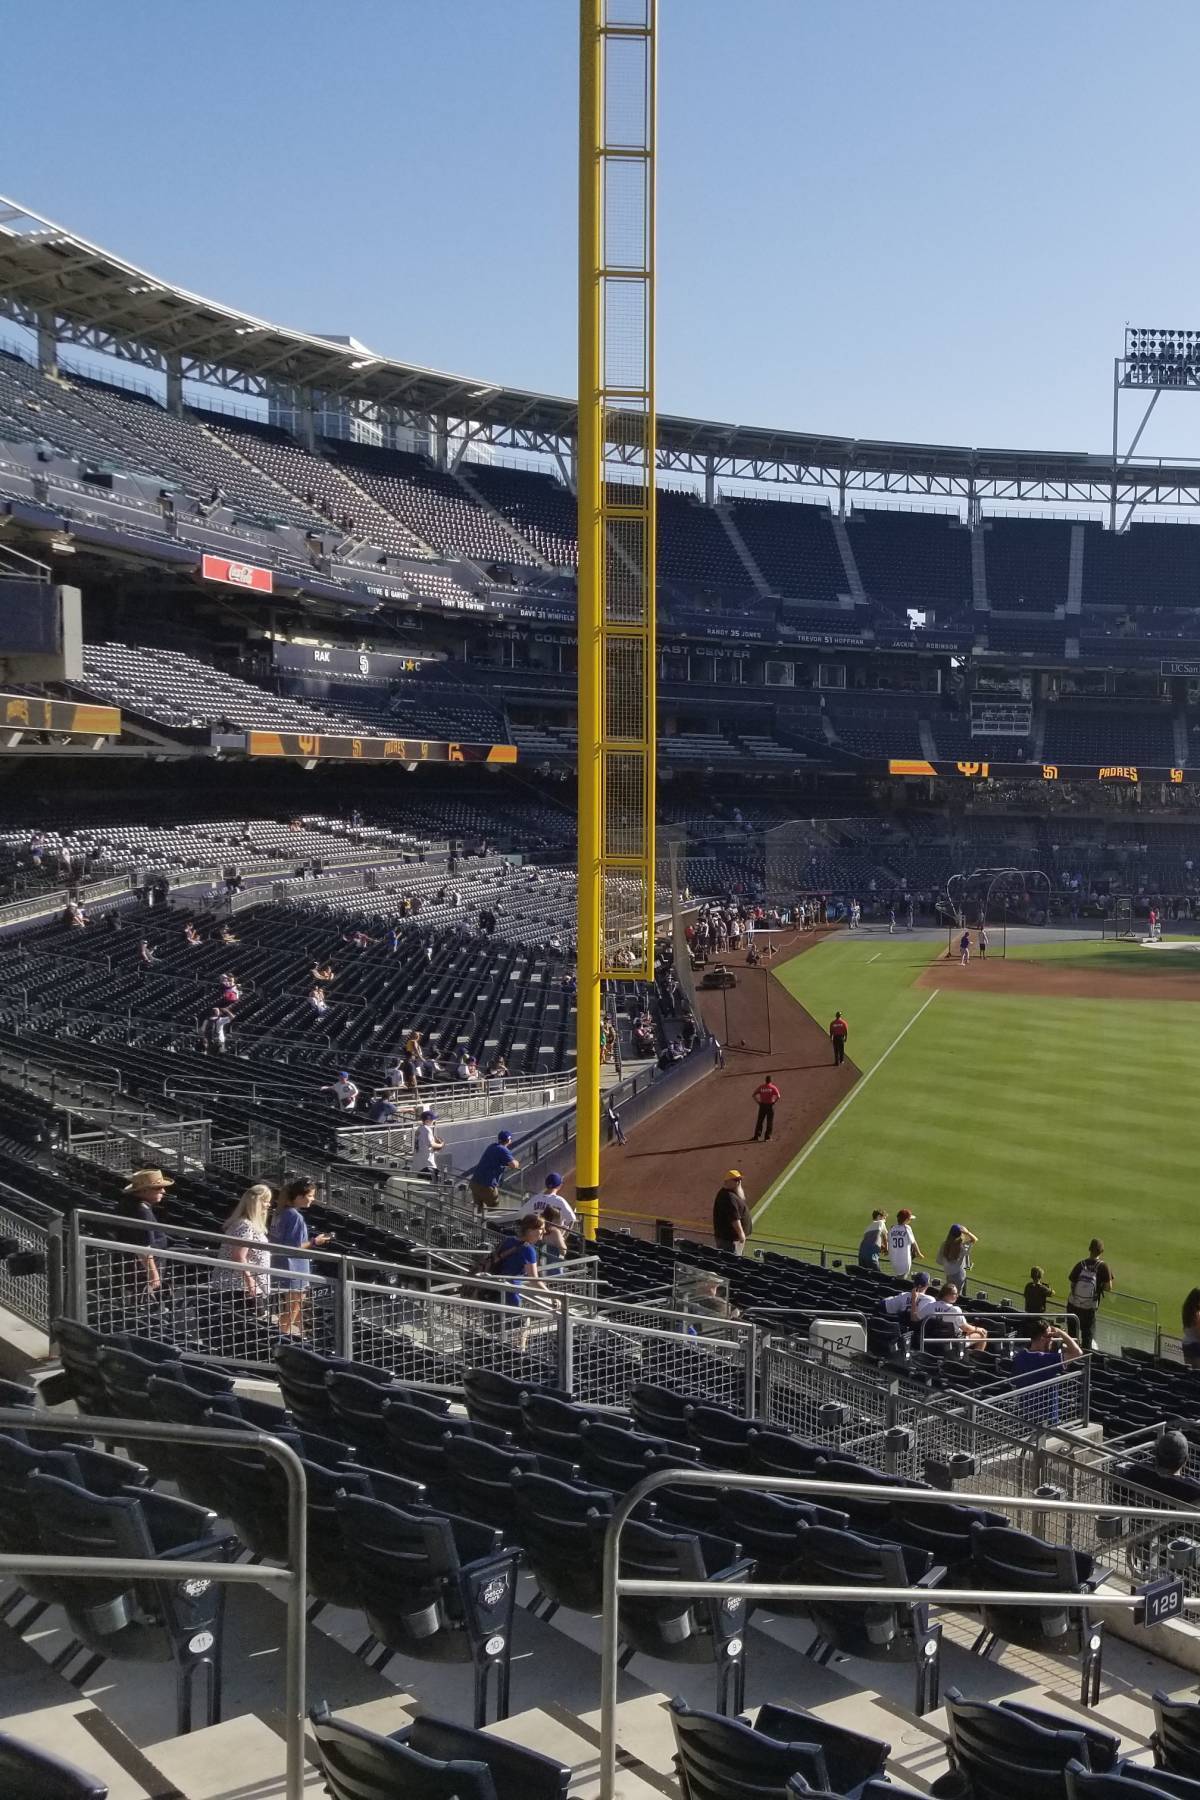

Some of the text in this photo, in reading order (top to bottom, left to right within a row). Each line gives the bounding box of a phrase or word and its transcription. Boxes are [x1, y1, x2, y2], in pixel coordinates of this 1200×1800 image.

[488, 630, 528, 641] JERRY
[696, 648, 750, 659] CENTER
[824, 636, 833, 644] 51
[315, 650, 330, 662] RAK
[1099, 767, 1139, 782] PADRES
[892, 1237, 904, 1248] 30
[1153, 1592, 1178, 1616] 129
